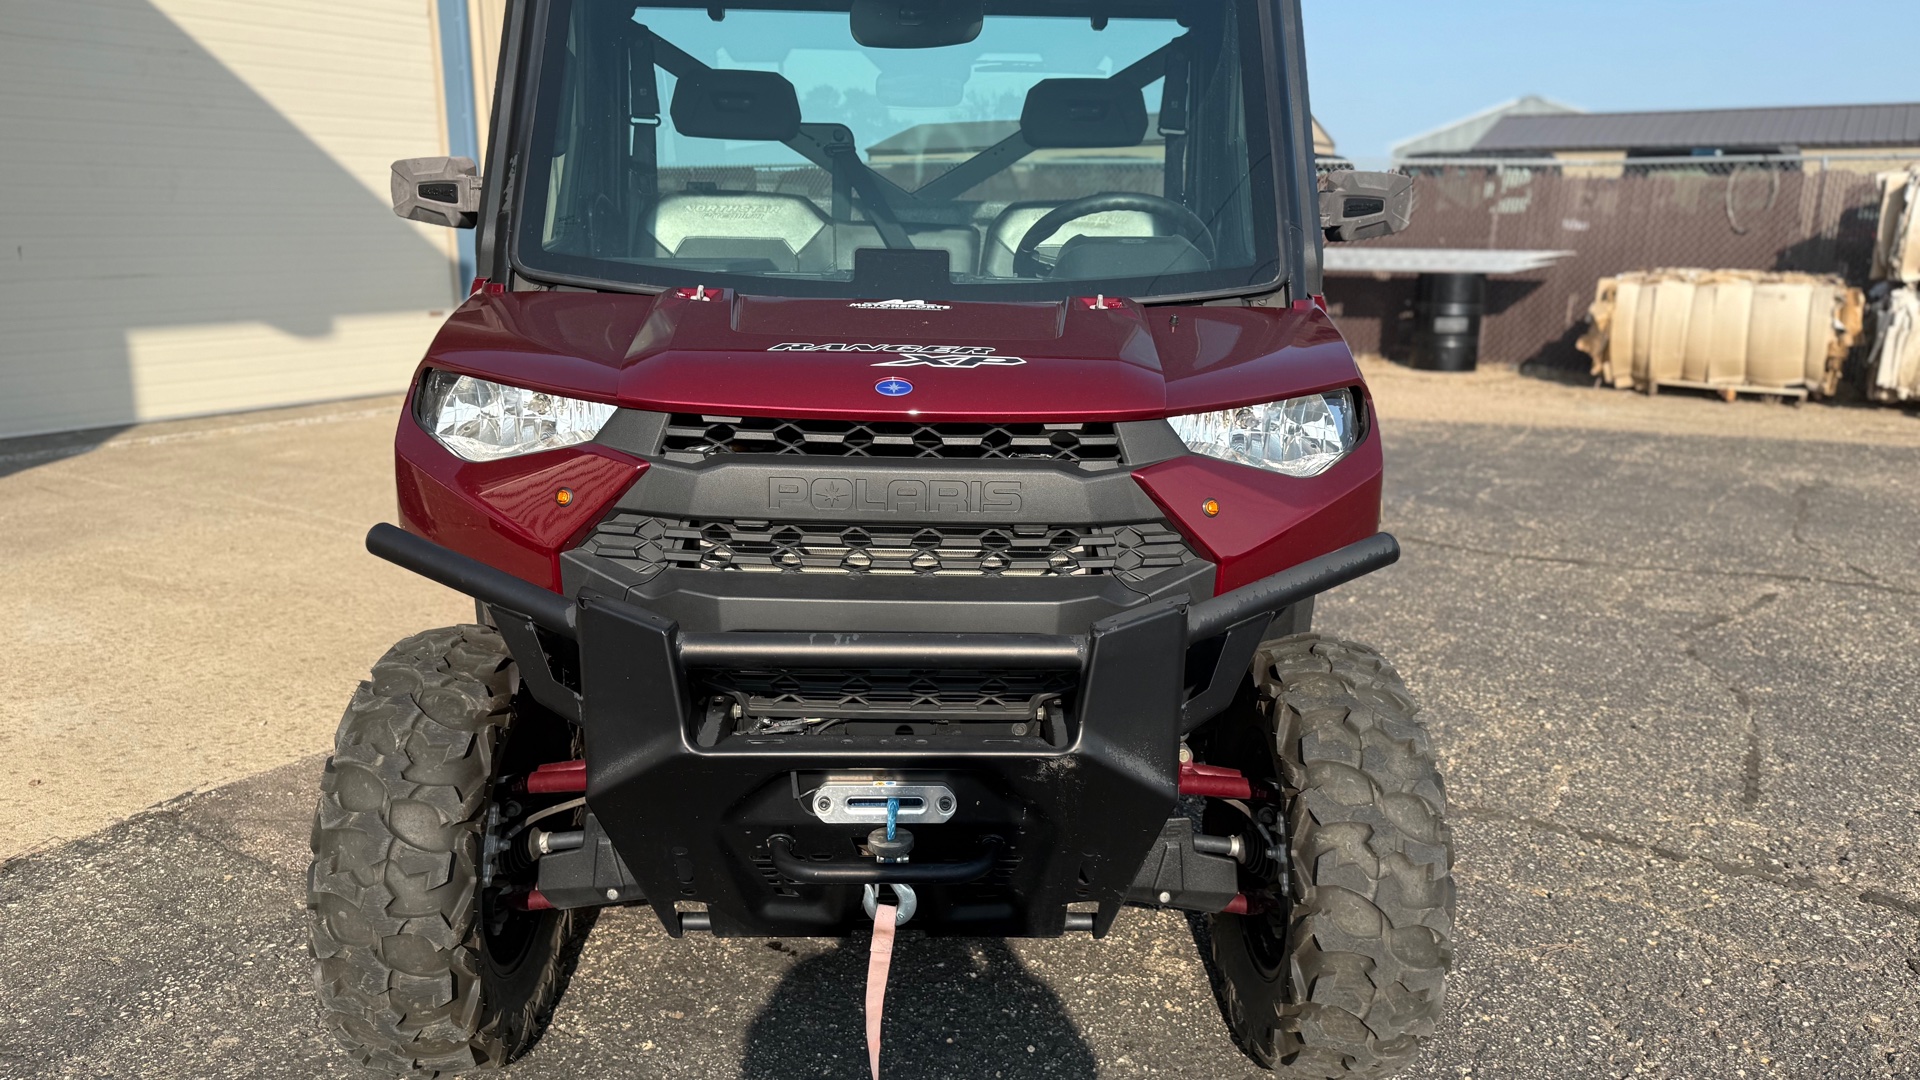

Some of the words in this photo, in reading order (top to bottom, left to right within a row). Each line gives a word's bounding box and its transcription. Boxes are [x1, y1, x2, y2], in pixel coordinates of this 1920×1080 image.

[684, 205, 784, 214] NORTHSTAR
[767, 342, 995, 355] RANGER
[869, 353, 1027, 369] XP
[768, 477, 1023, 513] POLARIS
